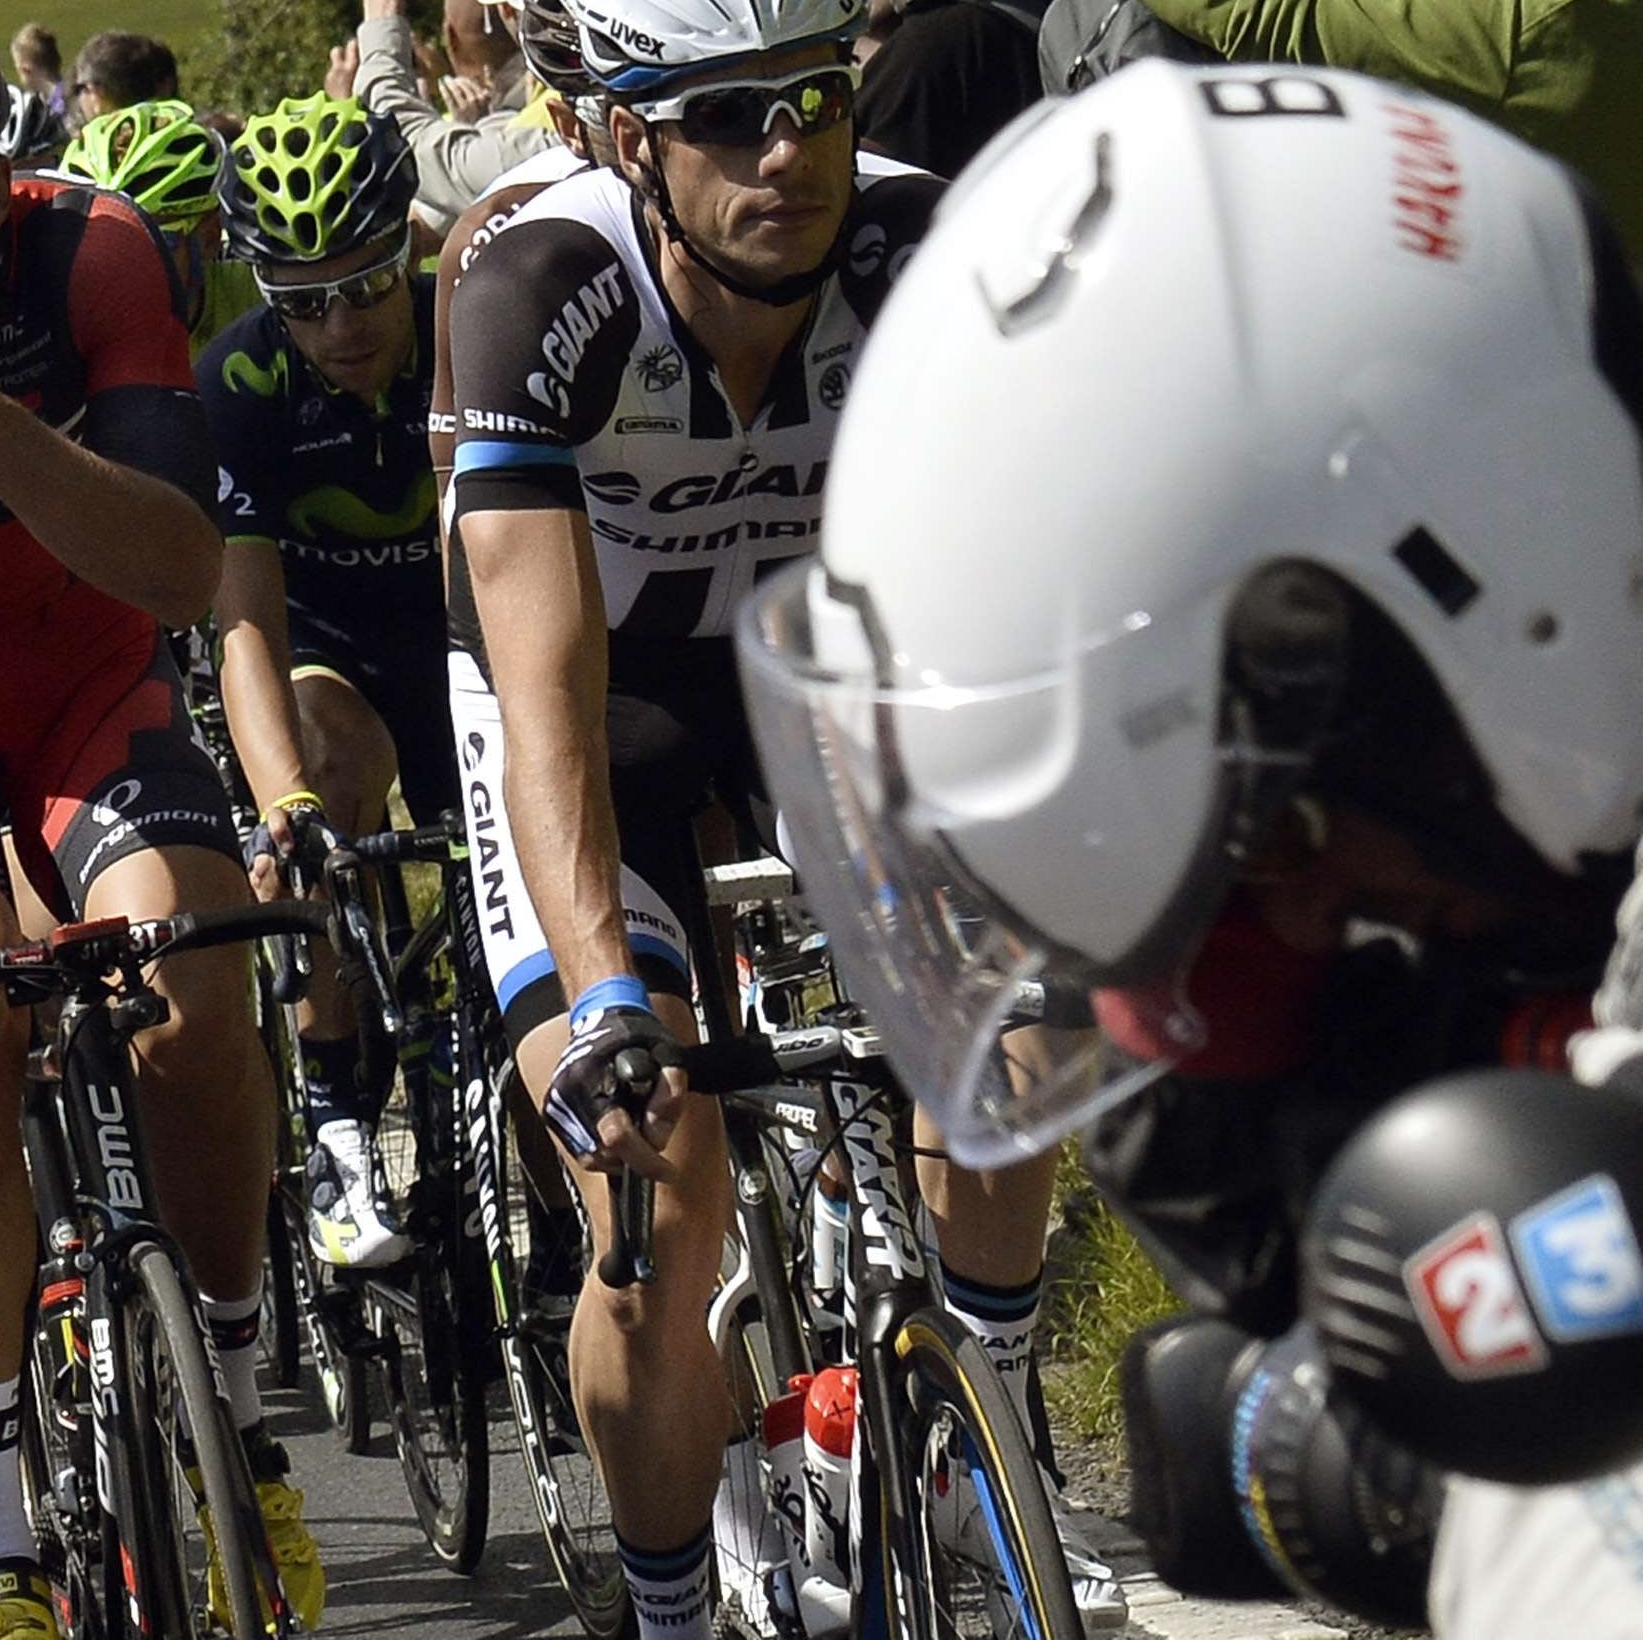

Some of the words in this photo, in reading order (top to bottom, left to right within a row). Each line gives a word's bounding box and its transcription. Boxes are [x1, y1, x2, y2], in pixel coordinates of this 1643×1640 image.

[609, 20, 667, 61] uvex
[542, 261, 625, 384] GIANT
[470, 780, 515, 941] GIANT
[129, 922, 158, 952] 3T
[88, 1084, 144, 1210] BMC
